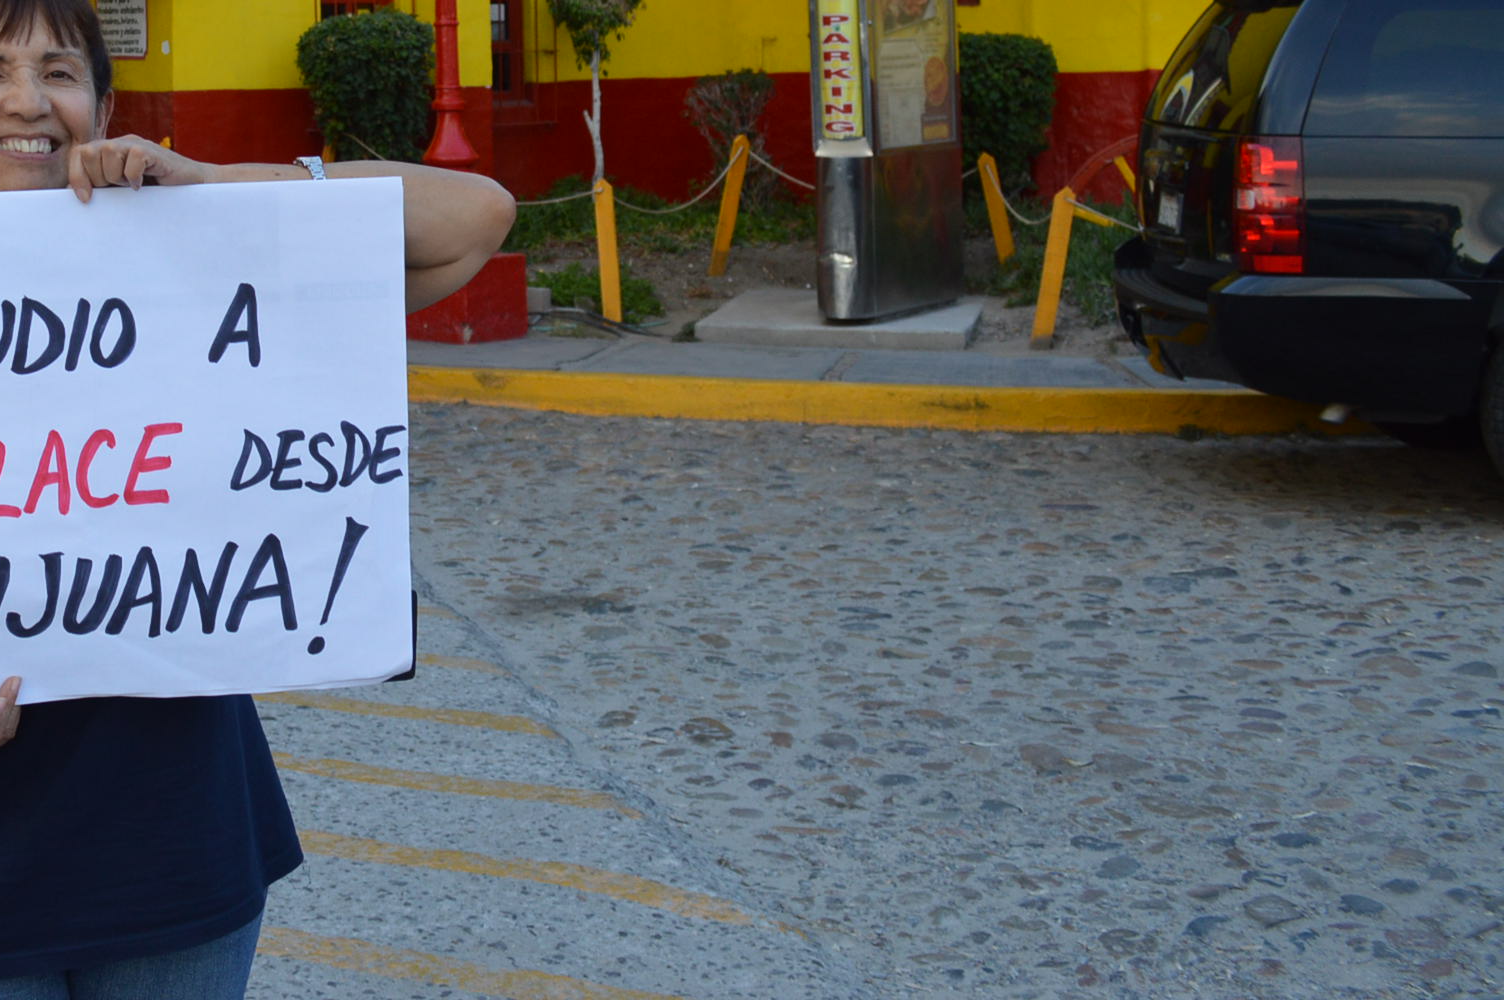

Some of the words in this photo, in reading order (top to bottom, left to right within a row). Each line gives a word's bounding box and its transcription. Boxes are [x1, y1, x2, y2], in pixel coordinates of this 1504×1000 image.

[822, 15, 855, 133] PARKING
[208, 283, 263, 368] A
[230, 420, 407, 492] DESDE
